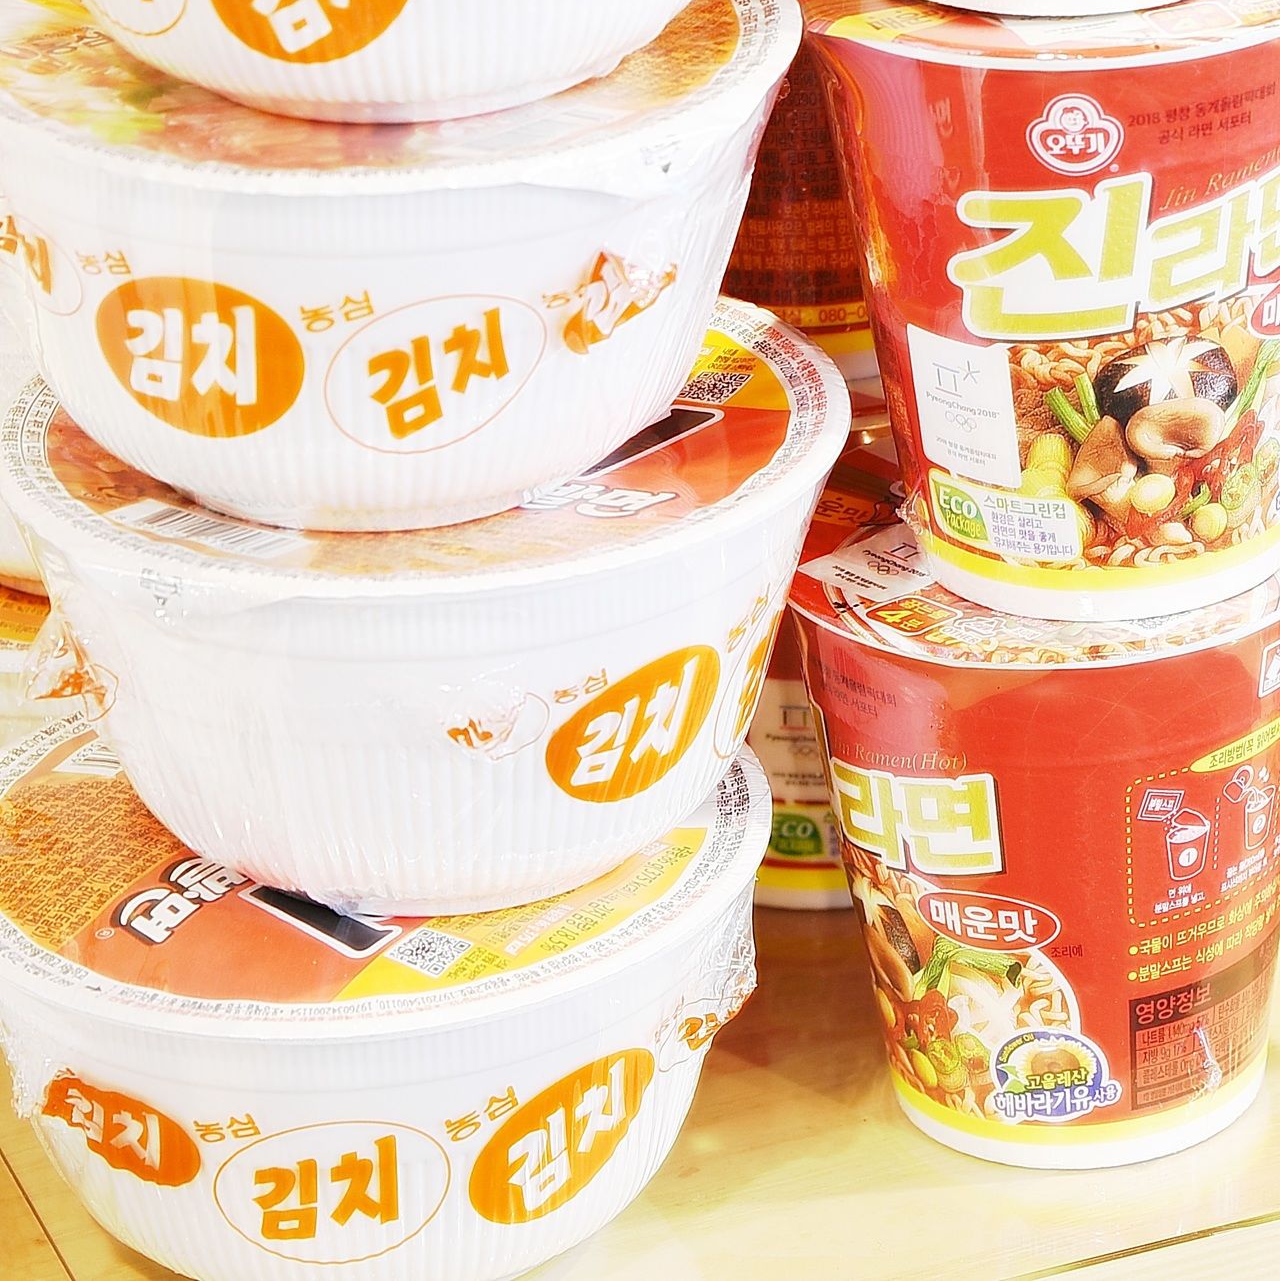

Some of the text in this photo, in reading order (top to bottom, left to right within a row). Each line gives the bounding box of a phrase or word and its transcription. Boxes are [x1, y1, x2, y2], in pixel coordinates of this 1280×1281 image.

[1046, 130, 1102, 156] 오뚜기
[124, 306, 258, 407] 김치
[367, 307, 510, 440] 김치
[983, 495, 1066, 519] 스마트그린컵
[570, 657, 701, 787] 김치
[831, 759, 1003, 874] 라면
[929, 898, 1039, 944] 매운맛
[1136, 983, 1212, 1025] 영양정보
[507, 1059, 632, 1211] 김치
[995, 1084, 1118, 1117] 해바라기유 사용
[253, 1135, 398, 1240] 김치
